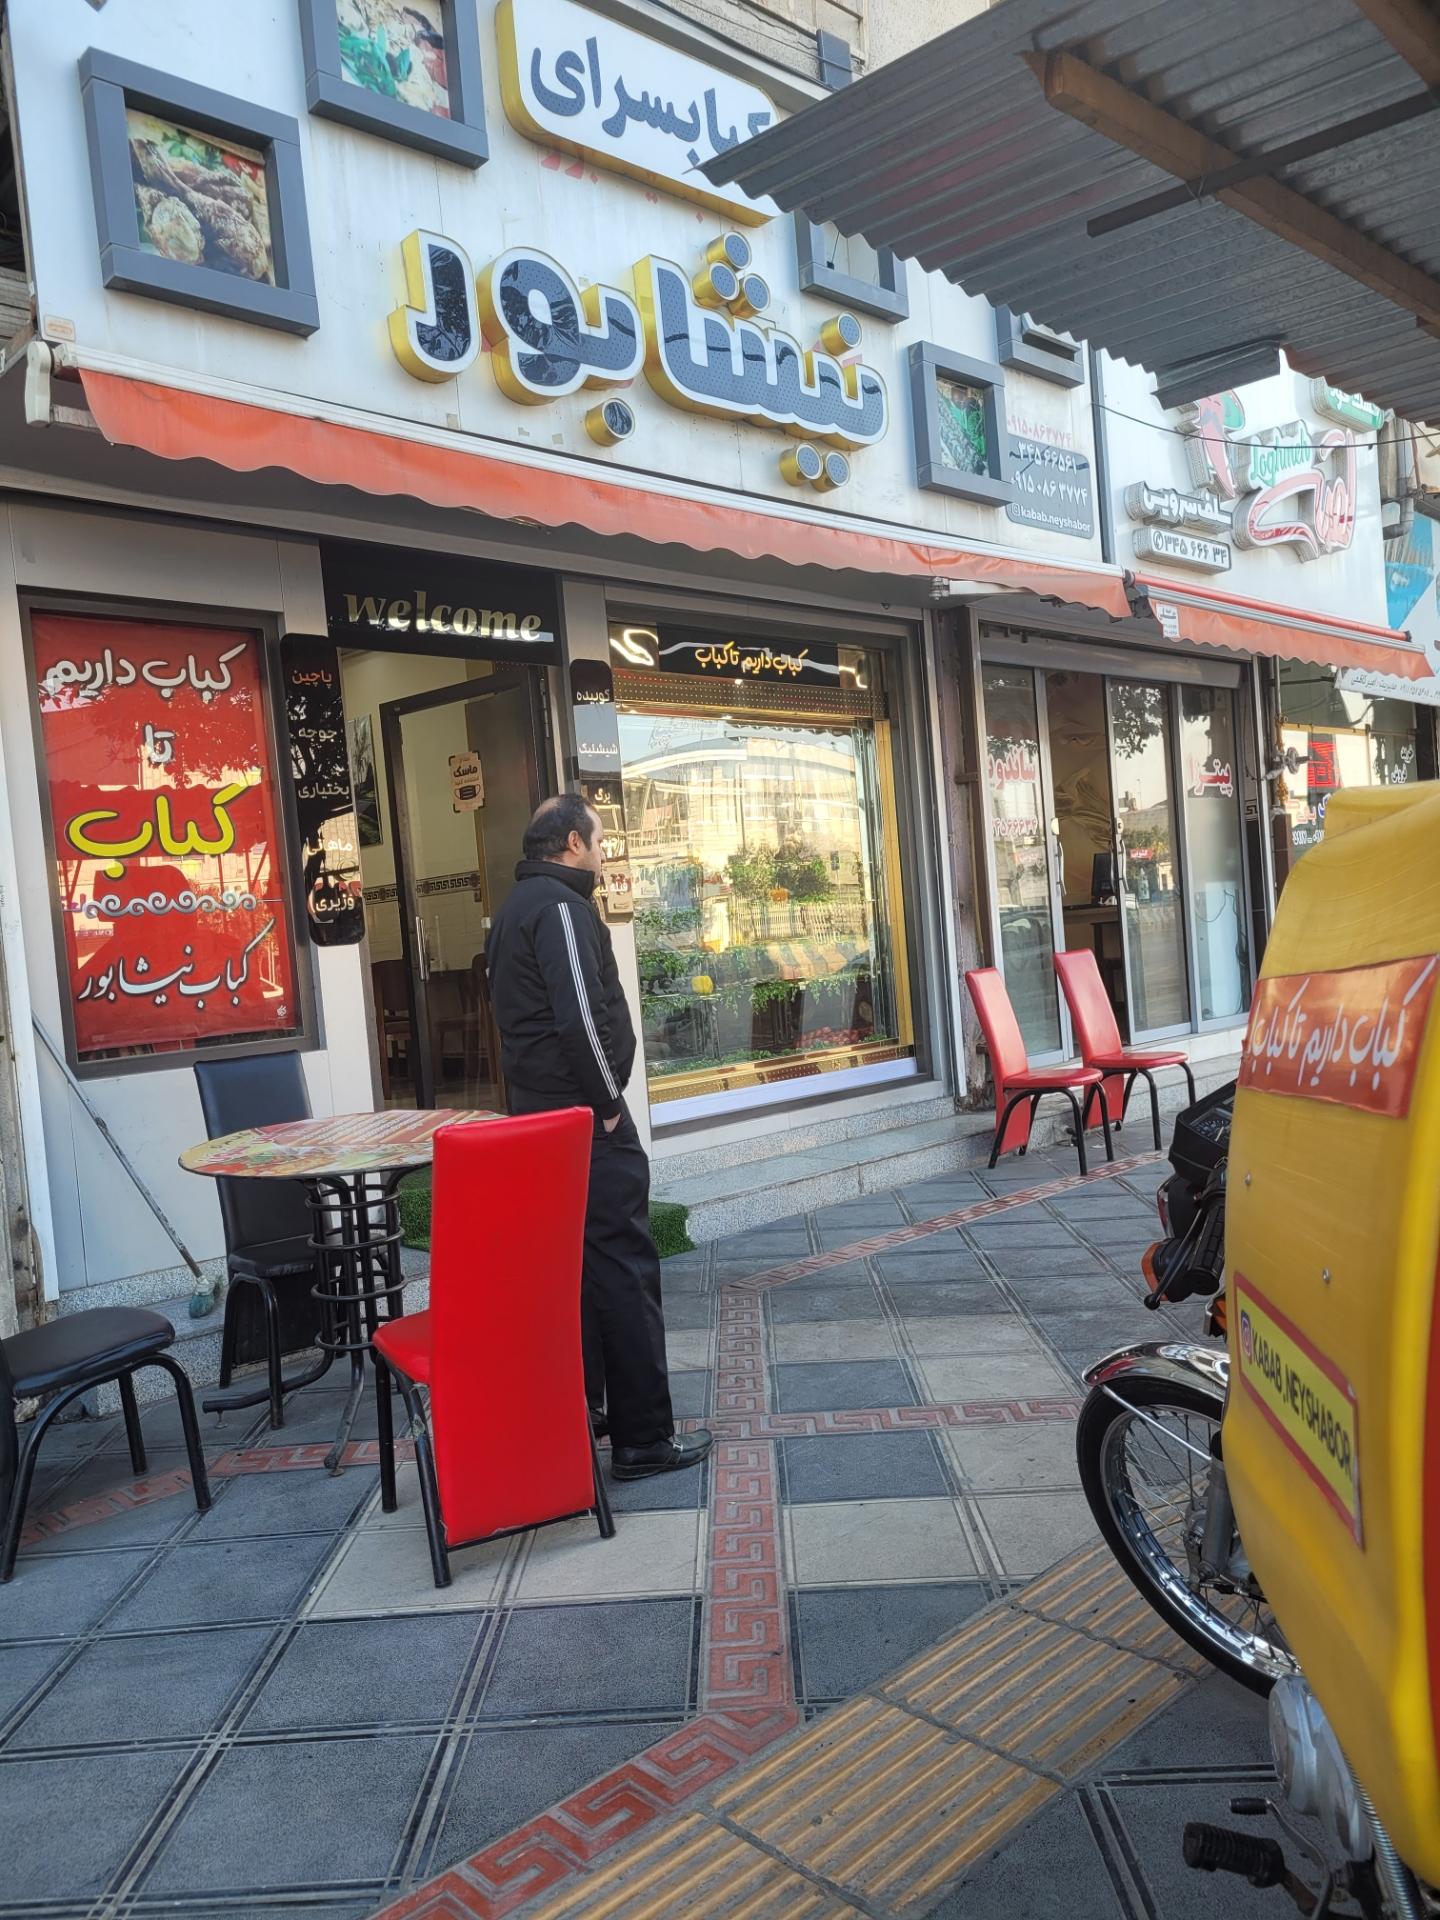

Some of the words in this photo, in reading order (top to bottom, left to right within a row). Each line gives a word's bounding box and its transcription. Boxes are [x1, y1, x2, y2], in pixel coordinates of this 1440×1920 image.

[388, 229, 890, 494] نیشابور
[343, 590, 542, 641] welcome
[46, 648, 136, 697] داریم
[142, 643, 247, 702] کباب
[292, 670, 332, 689] پاچین
[694, 640, 735, 670] کباب
[741, 651, 772, 674] داریم
[772, 648, 809, 677] کباب
[143, 723, 176, 764] تا
[299, 727, 338, 742] جوجه
[298, 782, 350, 800] بختیاری
[68, 770, 260, 879] کباب
[315, 894, 355, 911] وزیری
[78, 945, 194, 1005] نیشابور
[179, 918, 275, 1009] کباب
[1251, 977, 1311, 1076] کباب
[1298, 1003, 1348, 1087] داریم
[1349, 957, 1437, 1091] کباب
